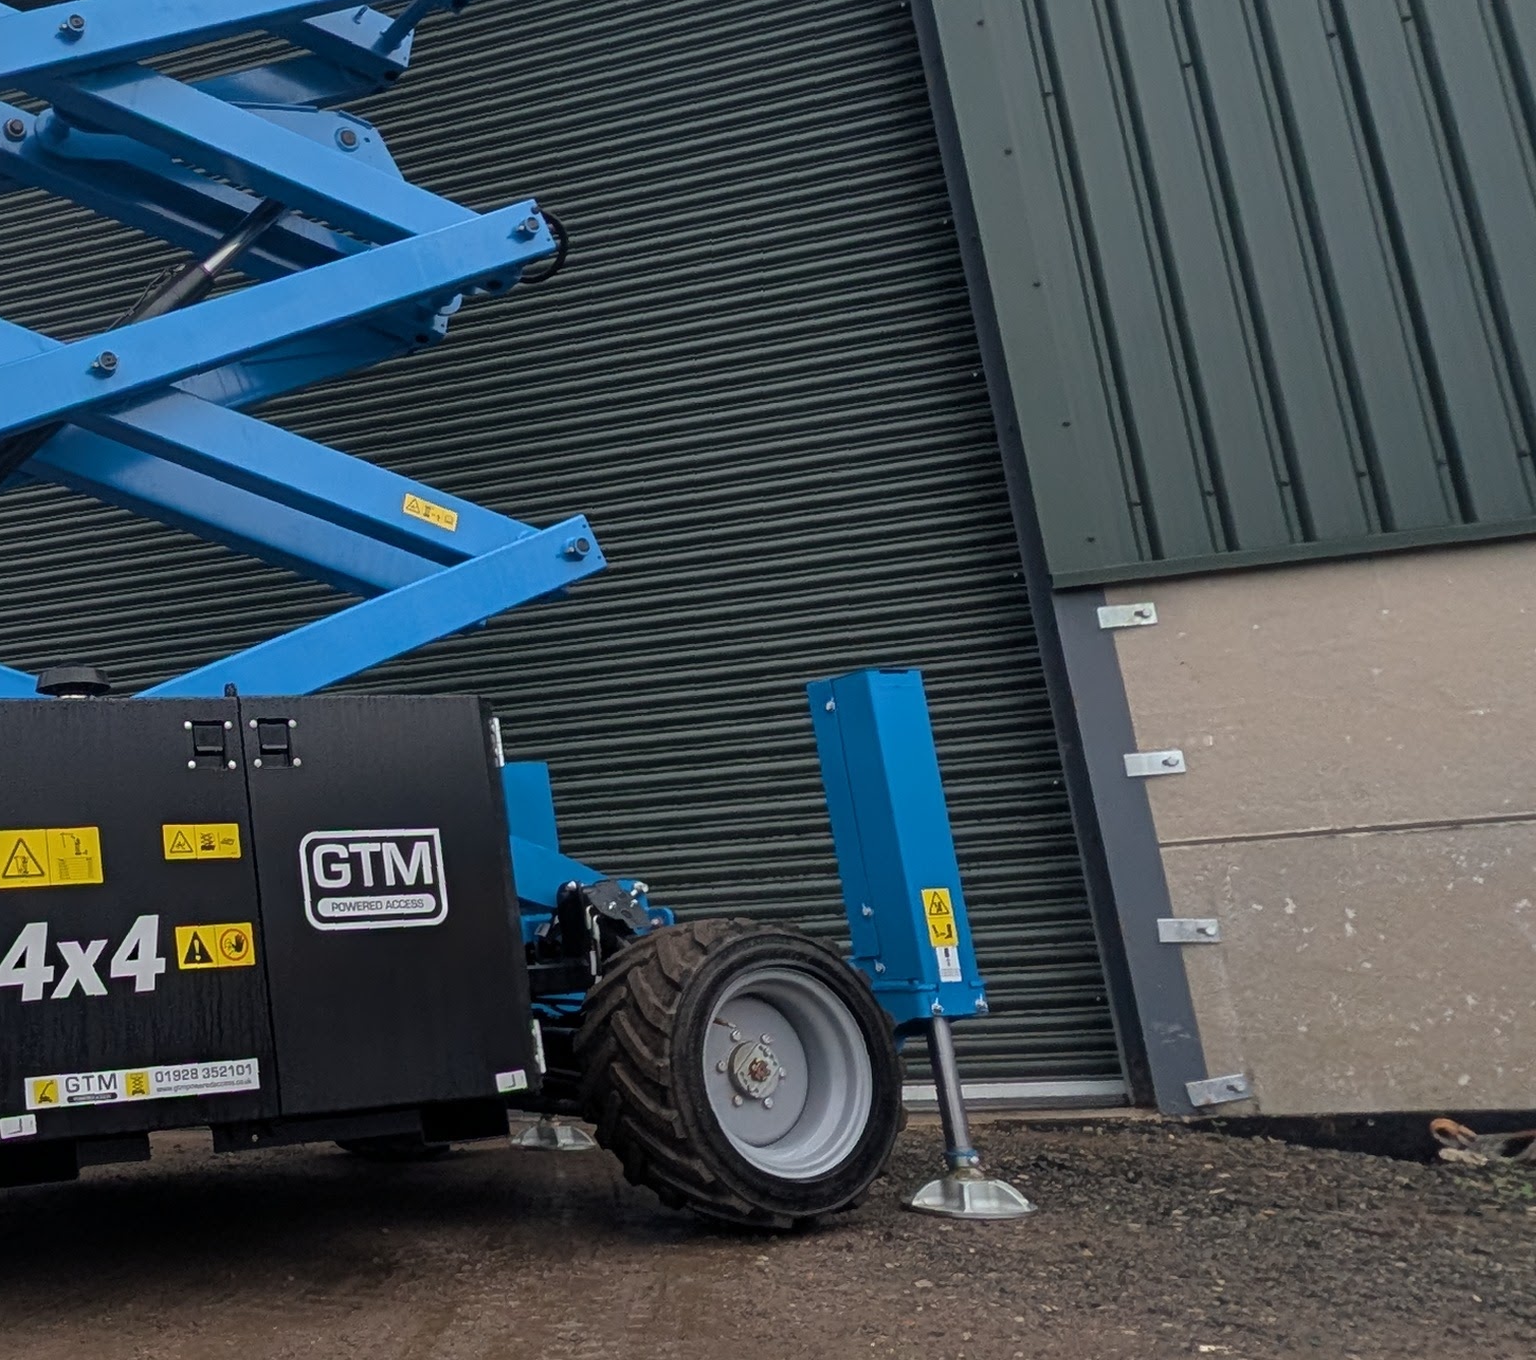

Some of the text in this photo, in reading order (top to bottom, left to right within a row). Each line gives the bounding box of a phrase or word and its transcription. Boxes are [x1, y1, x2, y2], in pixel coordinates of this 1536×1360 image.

[312, 841, 434, 889] GTM
[331, 898, 424, 912] POWERED ACCESS
[65, 1072, 118, 1093] GTM
[154, 1064, 252, 1083] 01928 352101
